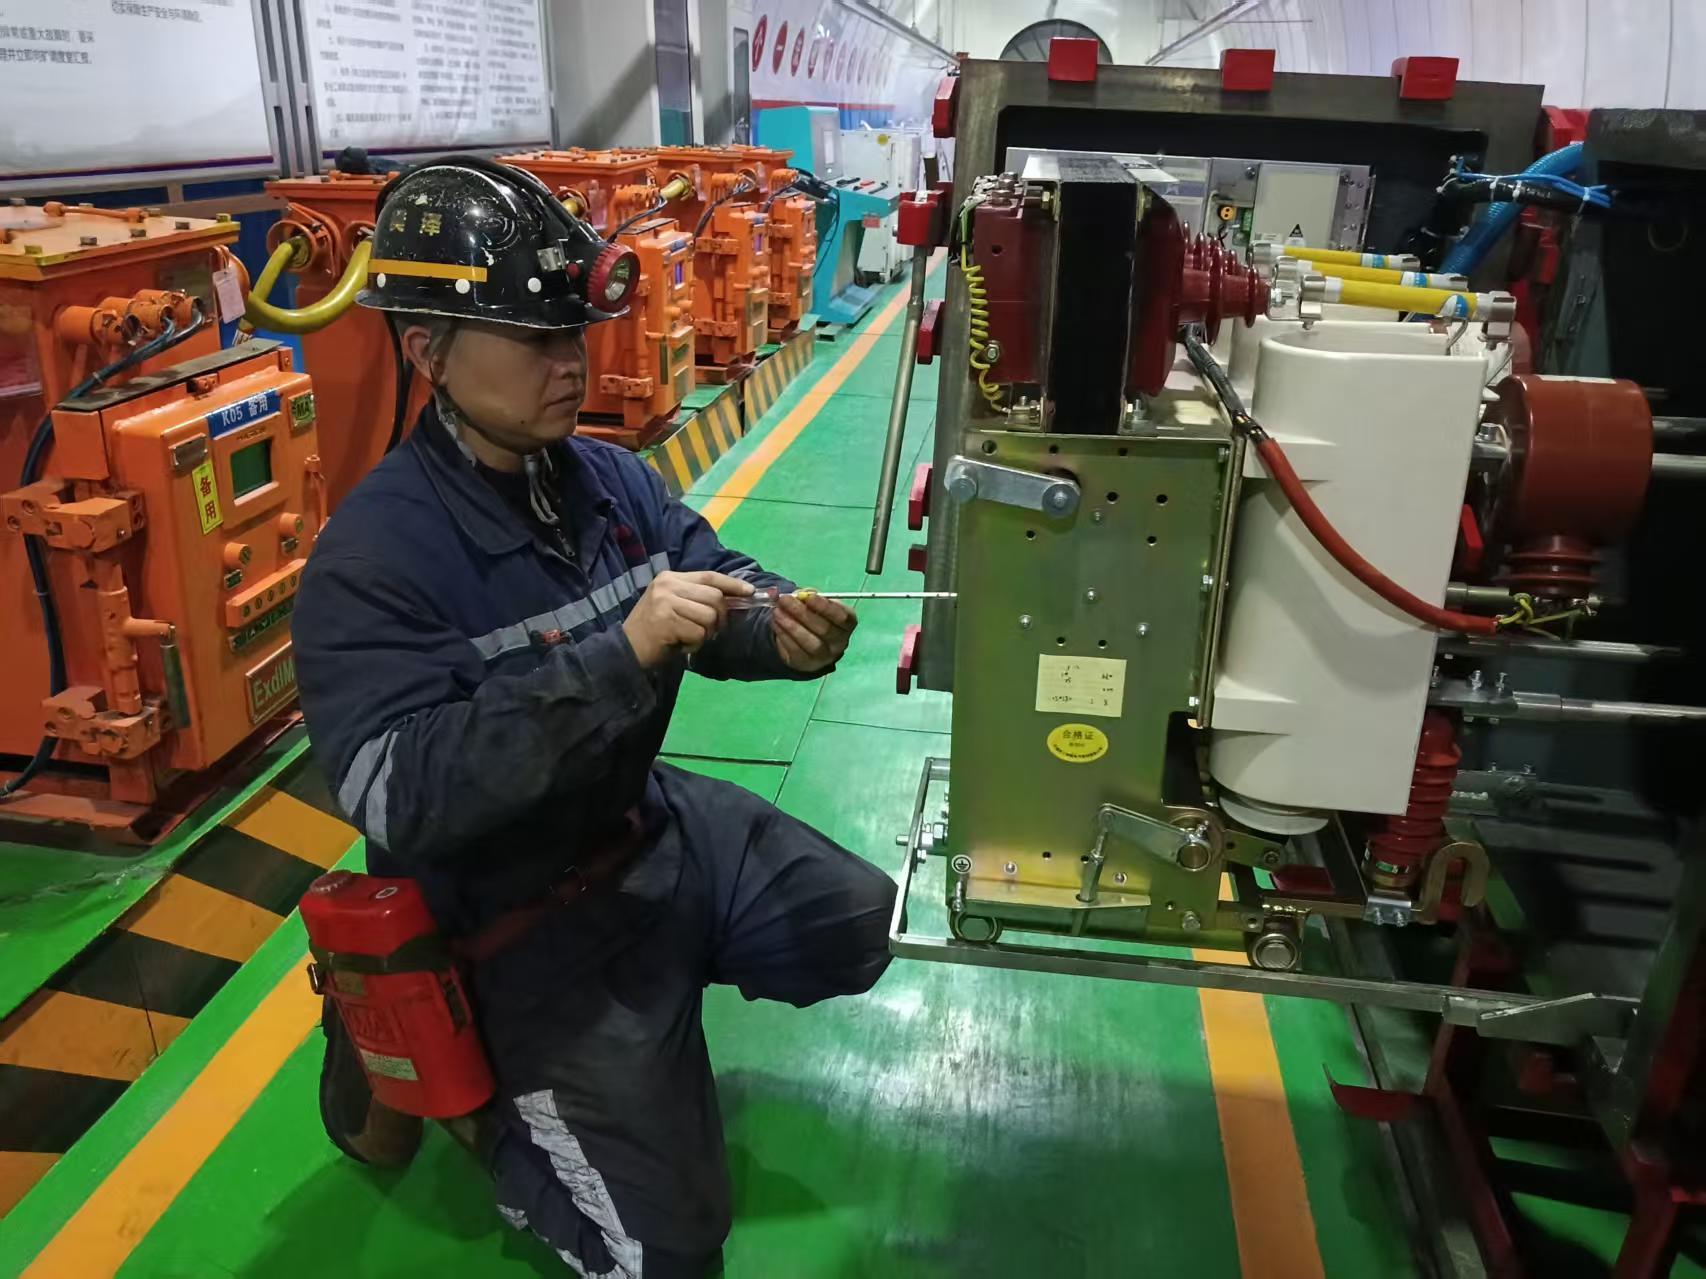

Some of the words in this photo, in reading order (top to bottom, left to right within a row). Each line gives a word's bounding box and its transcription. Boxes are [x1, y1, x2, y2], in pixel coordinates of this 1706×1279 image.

[221, 406, 243, 427] K05
[248, 394, 268, 417] 备用
[200, 475, 217, 523] 备用
[1062, 729, 1095, 741] 合格证
